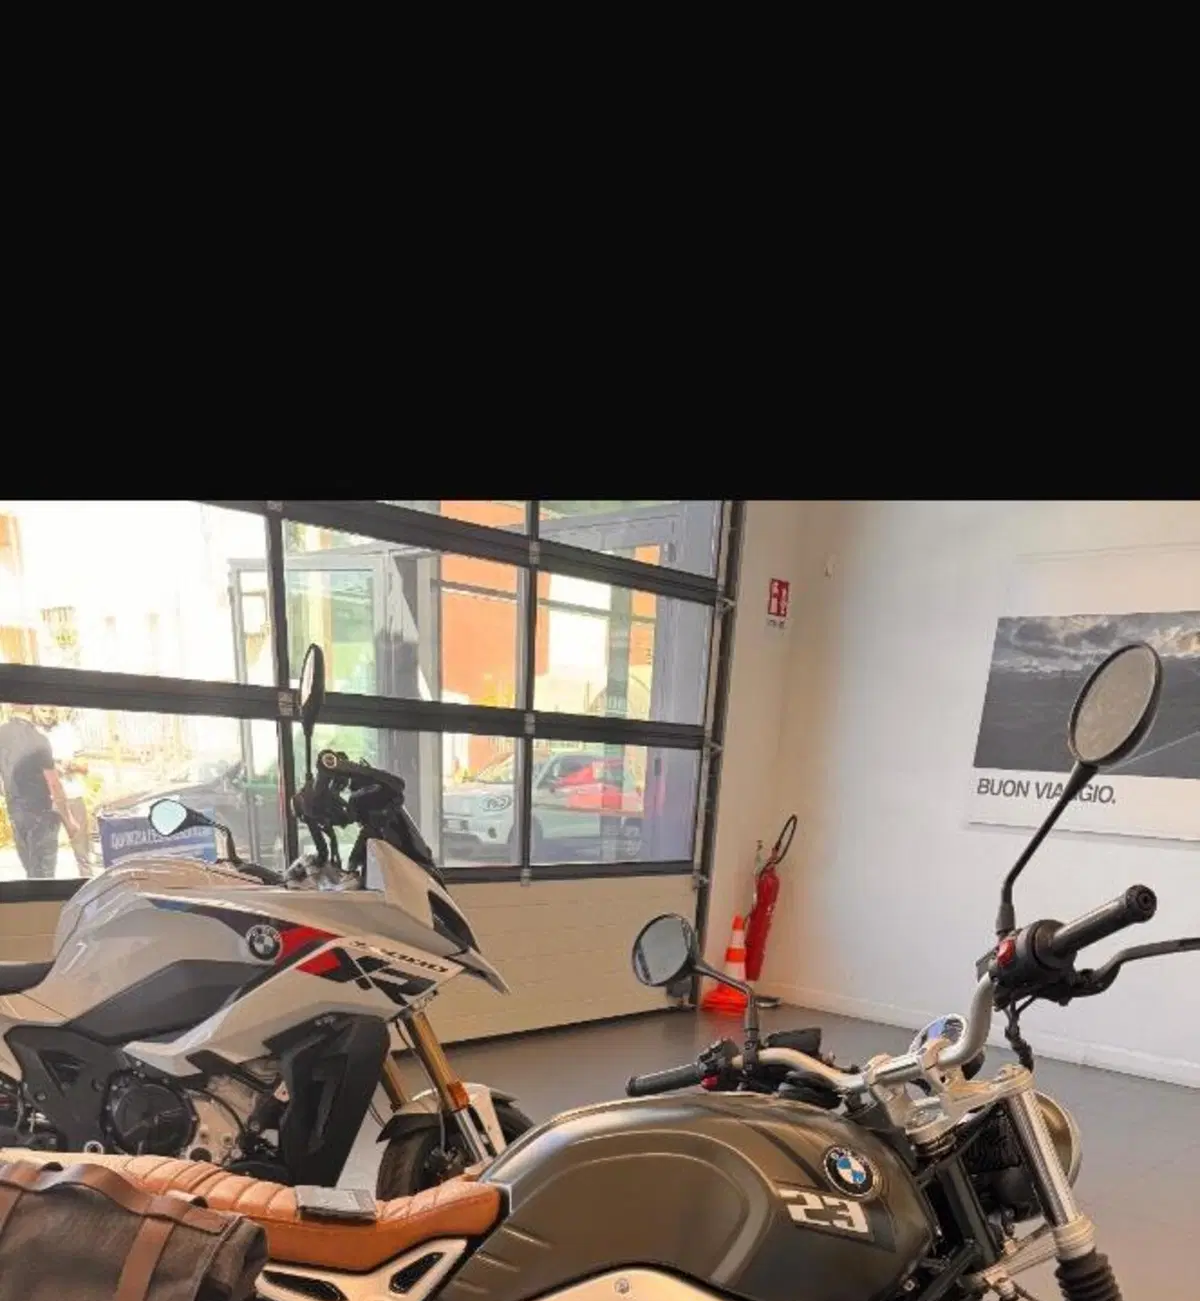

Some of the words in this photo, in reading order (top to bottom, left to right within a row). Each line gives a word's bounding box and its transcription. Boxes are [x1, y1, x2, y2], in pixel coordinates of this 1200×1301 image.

[977, 778, 1030, 798] BUON
[1035, 781, 1116, 804] VIAGIO.
[779, 1188, 869, 1233] 23
